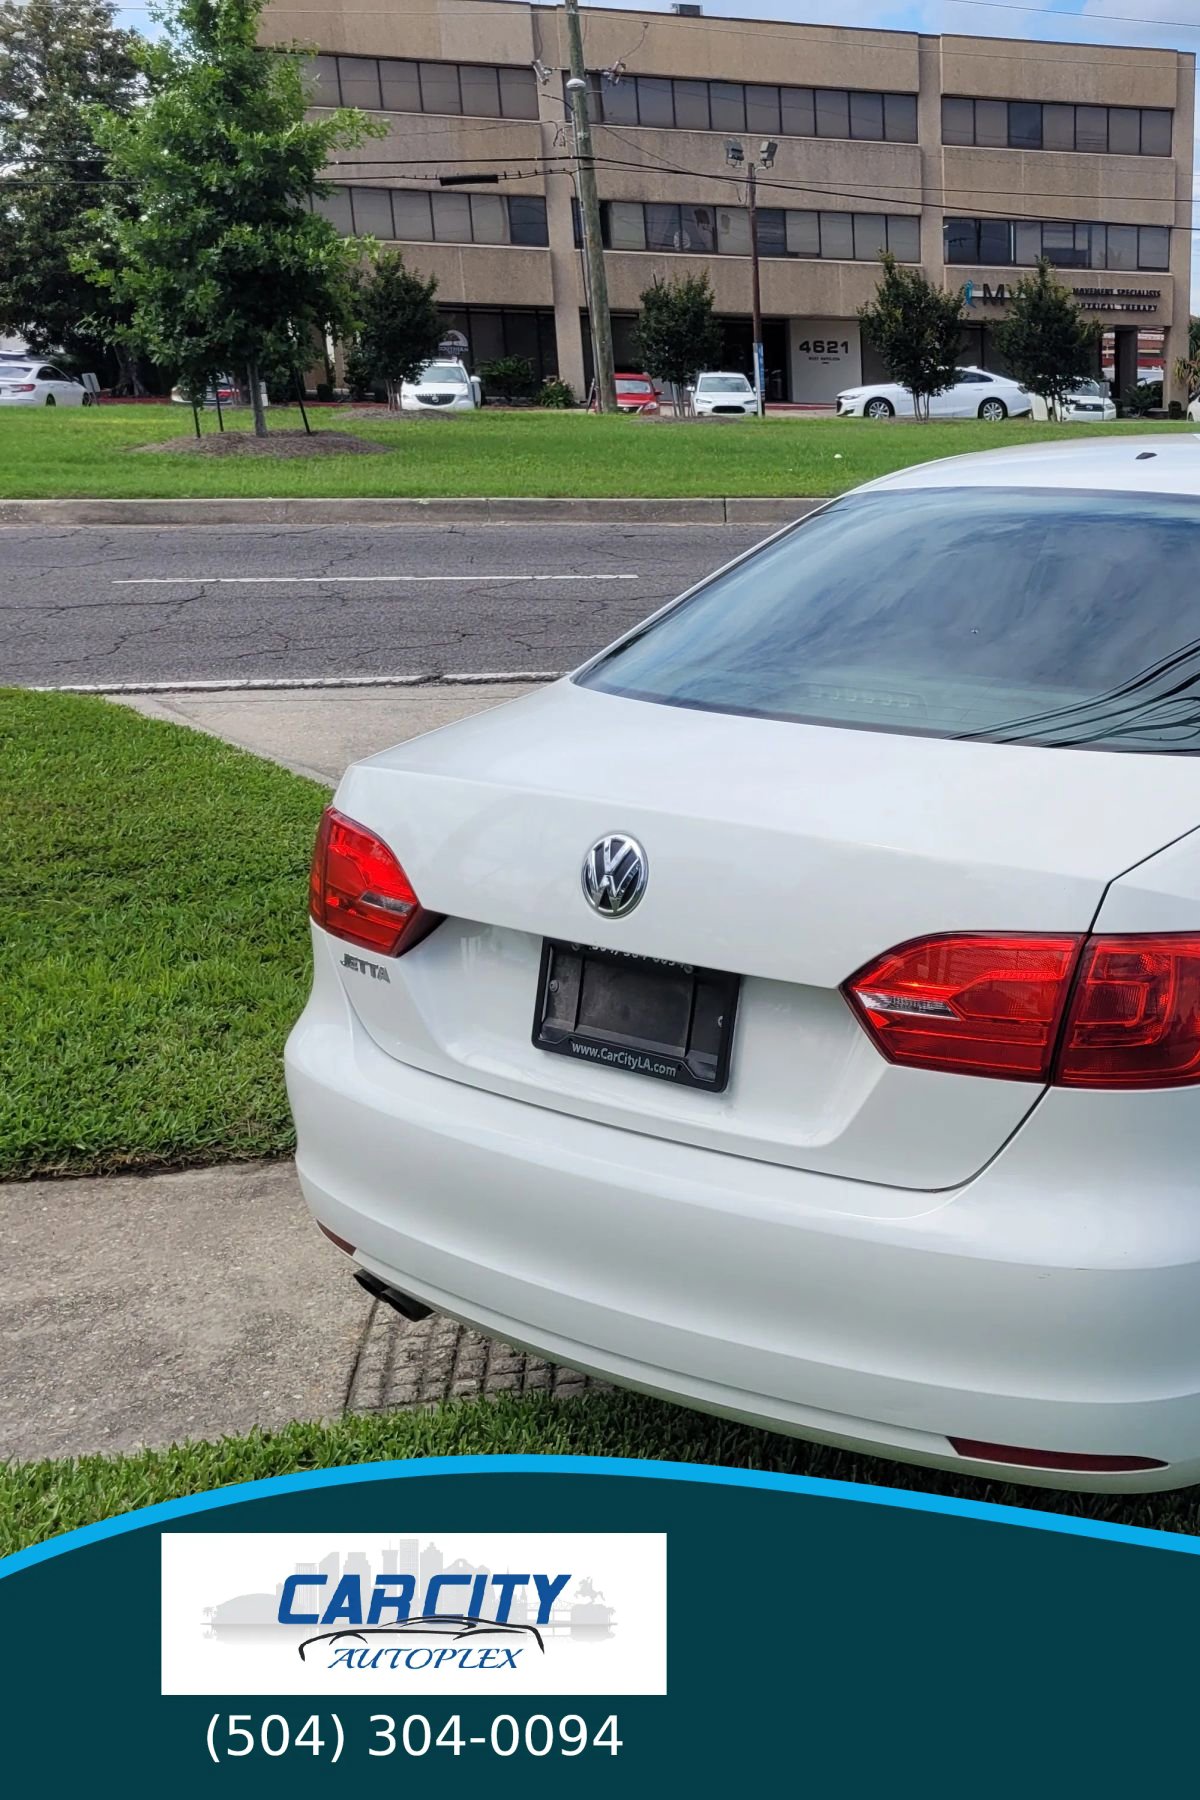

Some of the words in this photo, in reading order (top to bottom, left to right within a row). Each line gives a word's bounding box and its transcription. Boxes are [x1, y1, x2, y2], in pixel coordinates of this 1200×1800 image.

[799, 340, 849, 354] 4621
[340, 953, 391, 984] JETTA
[572, 1043, 677, 1078] www.CarCityLA.com
